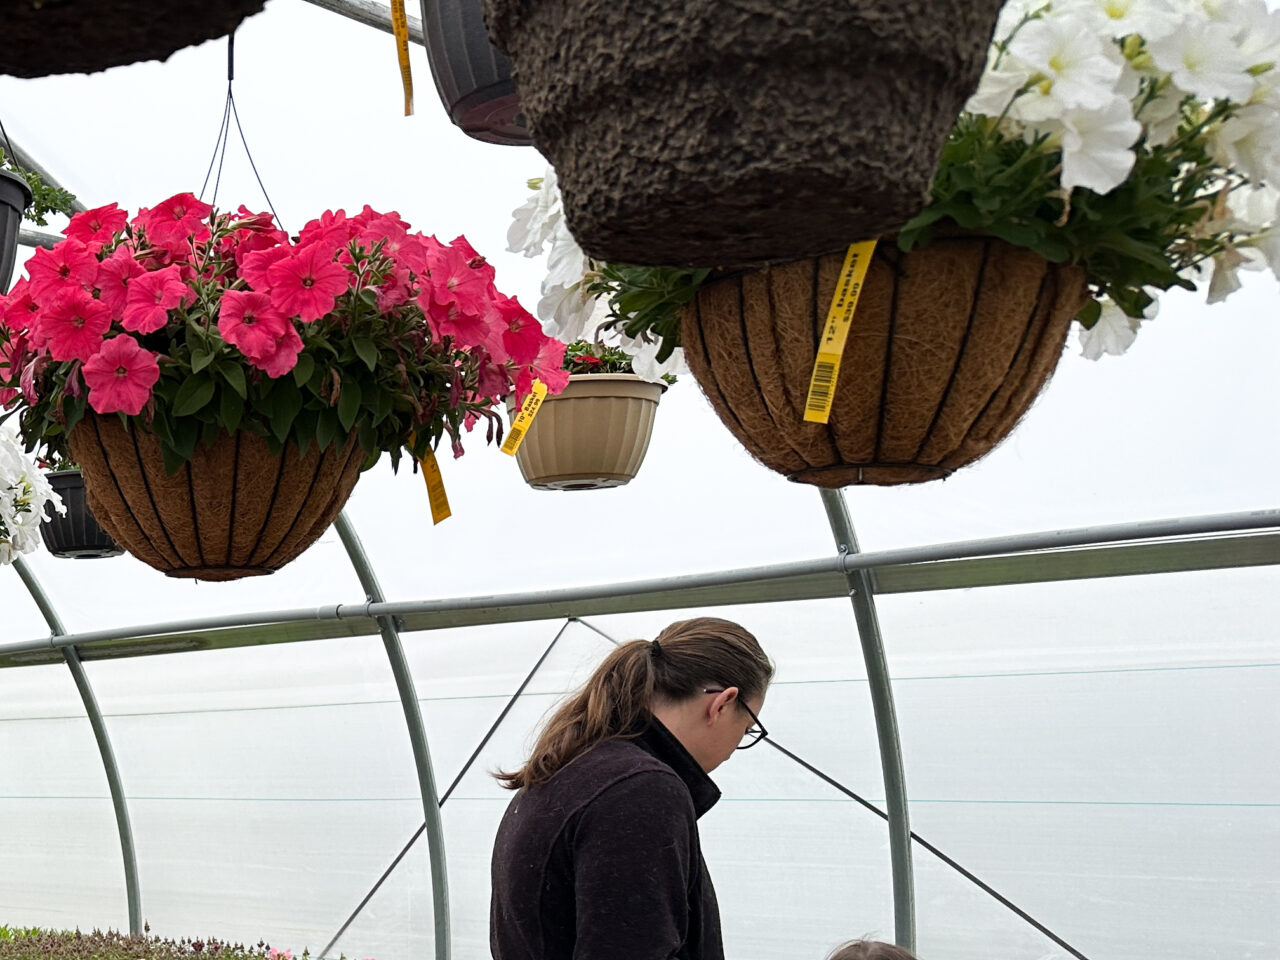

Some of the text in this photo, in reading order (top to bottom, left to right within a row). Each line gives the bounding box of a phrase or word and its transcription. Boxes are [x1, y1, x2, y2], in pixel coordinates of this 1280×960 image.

[826, 252, 860, 345] 12" basket
[842, 282, 860, 324] $39.99
[524, 391, 539, 412] Basket
[527, 398, 541, 418] $24.99
